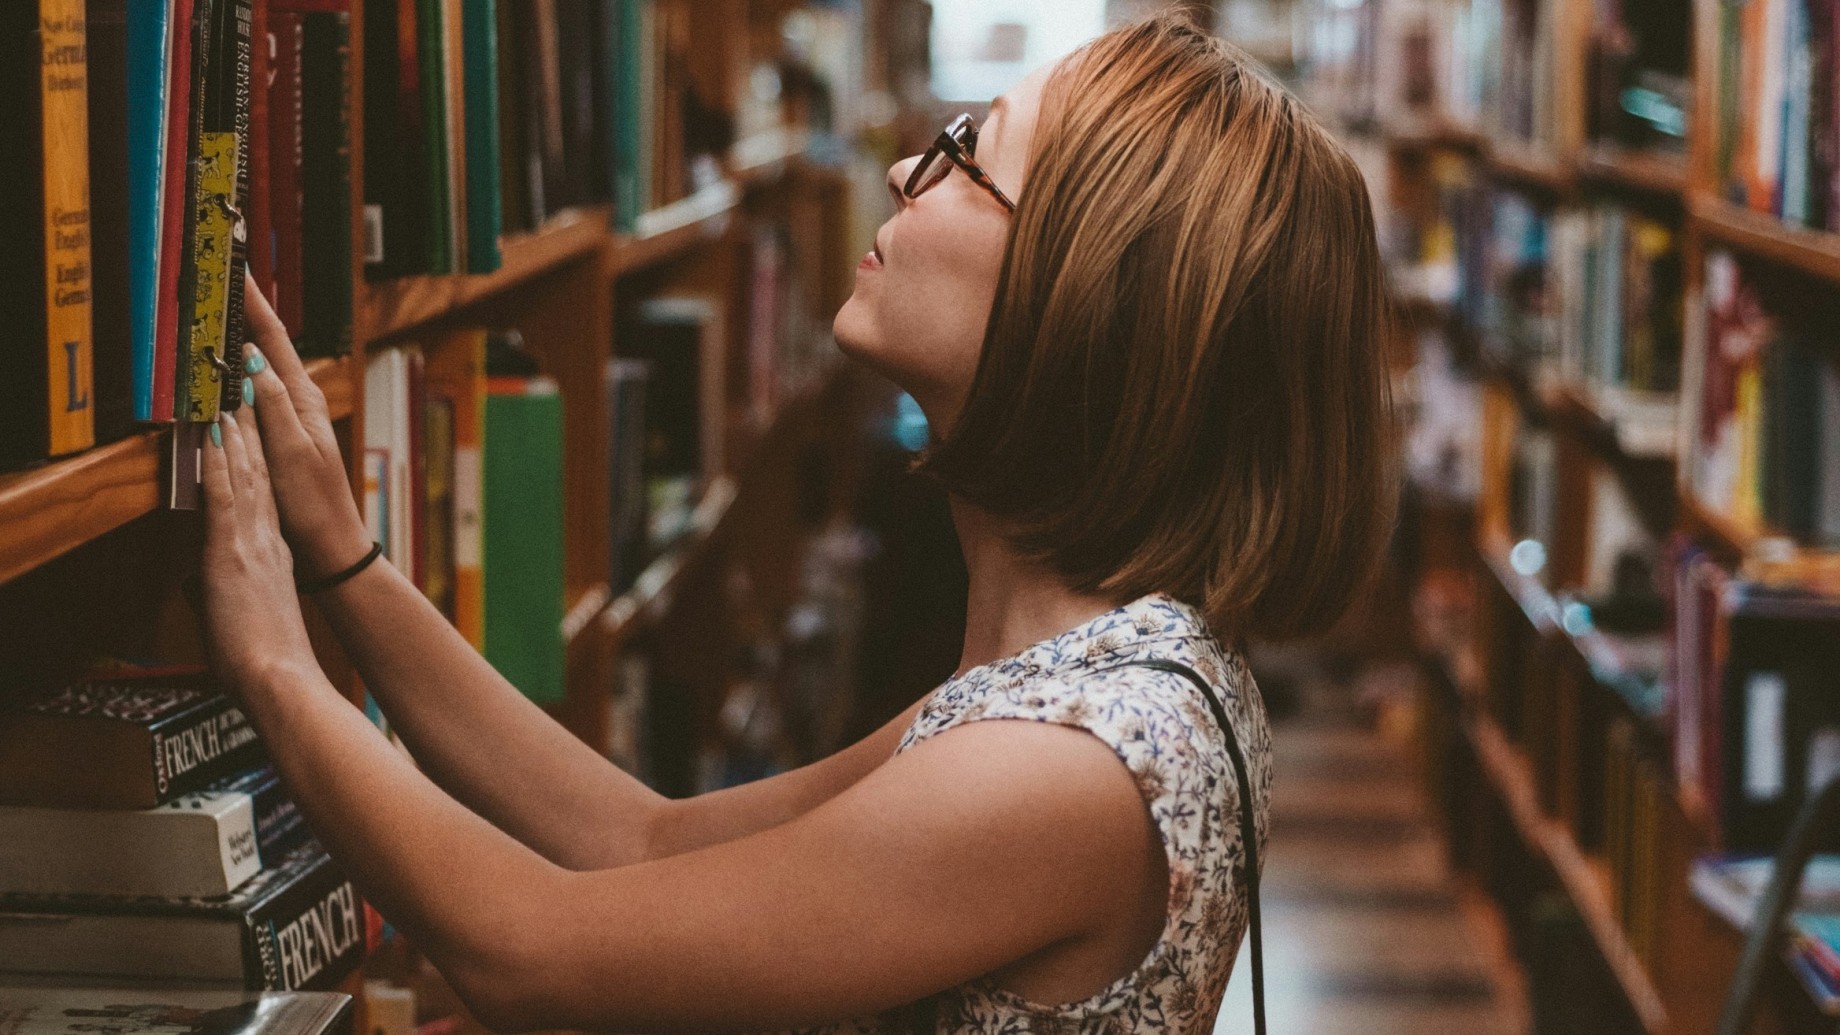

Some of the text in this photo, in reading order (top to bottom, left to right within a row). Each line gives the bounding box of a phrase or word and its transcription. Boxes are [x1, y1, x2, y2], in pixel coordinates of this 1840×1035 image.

[241, 43, 250, 178] GERMAN-ENGLISH
[63, 341, 89, 413] L
[164, 716, 221, 779] FRENCH
[277, 880, 360, 991] FRENCH
